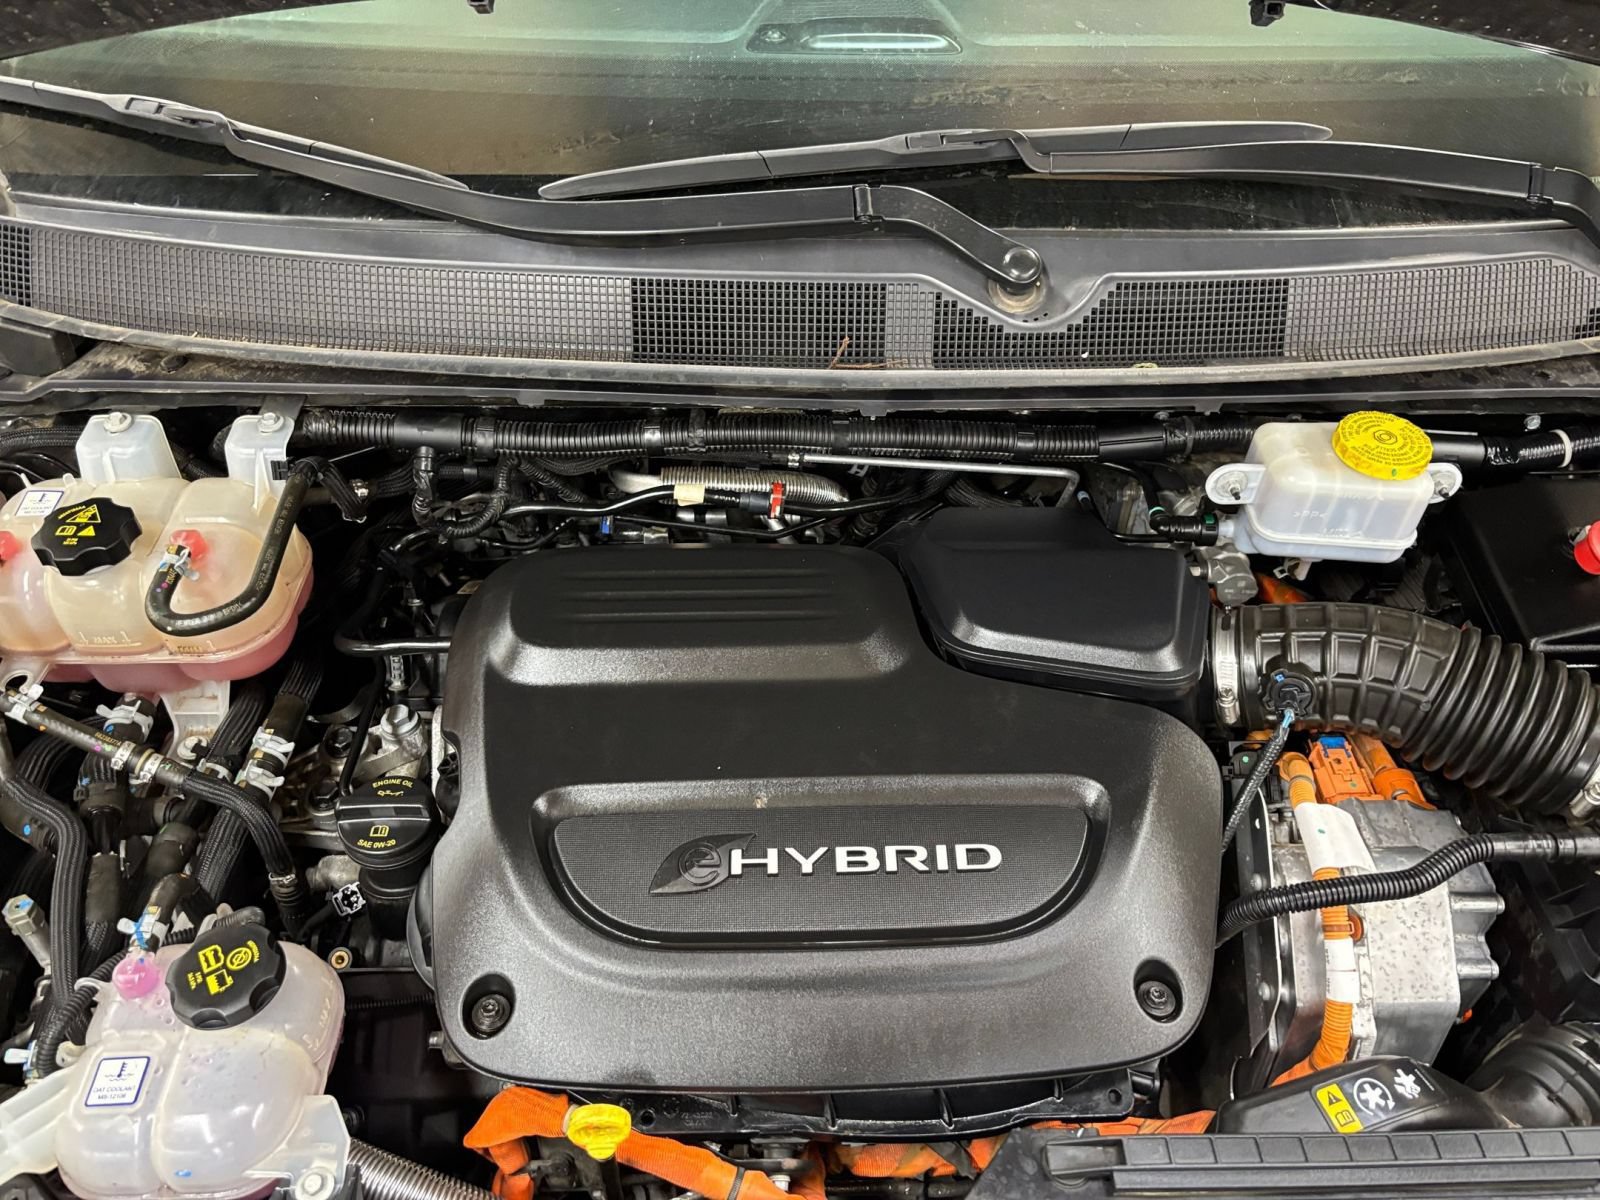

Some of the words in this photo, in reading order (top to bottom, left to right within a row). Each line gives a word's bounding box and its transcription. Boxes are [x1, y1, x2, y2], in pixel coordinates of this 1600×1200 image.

[372, 779, 401, 788] ENGINE
[402, 779, 414, 788] OIL
[357, 839, 372, 848] SAE
[373, 839, 396, 848] 0W-20
